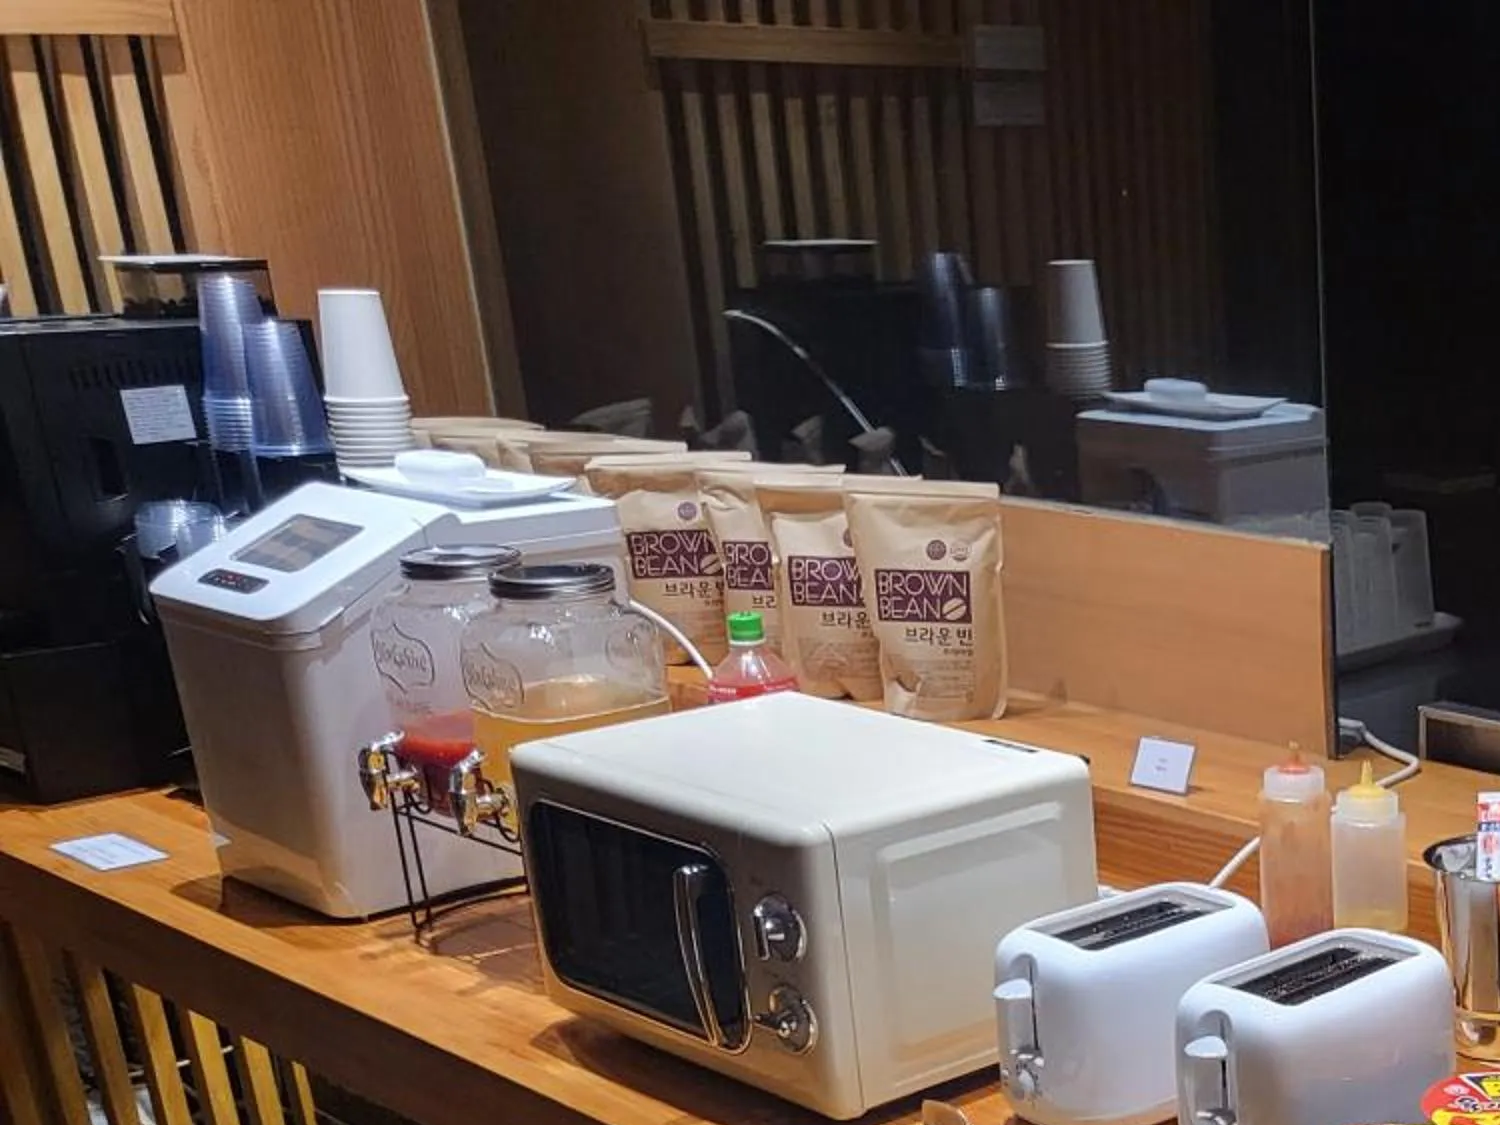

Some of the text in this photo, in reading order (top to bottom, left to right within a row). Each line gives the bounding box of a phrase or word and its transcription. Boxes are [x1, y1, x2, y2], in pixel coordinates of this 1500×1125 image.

[726, 543, 769, 565] BRO
[634, 556, 699, 577] BEAN
[728, 567, 772, 587] BEA
[791, 558, 859, 581] BROW
[663, 582, 713, 599] 브라운
[794, 581, 857, 604] BEAN
[878, 571, 967, 596] BROWN
[880, 596, 941, 619] BEAN
[905, 626, 973, 646] 브라운 빈
